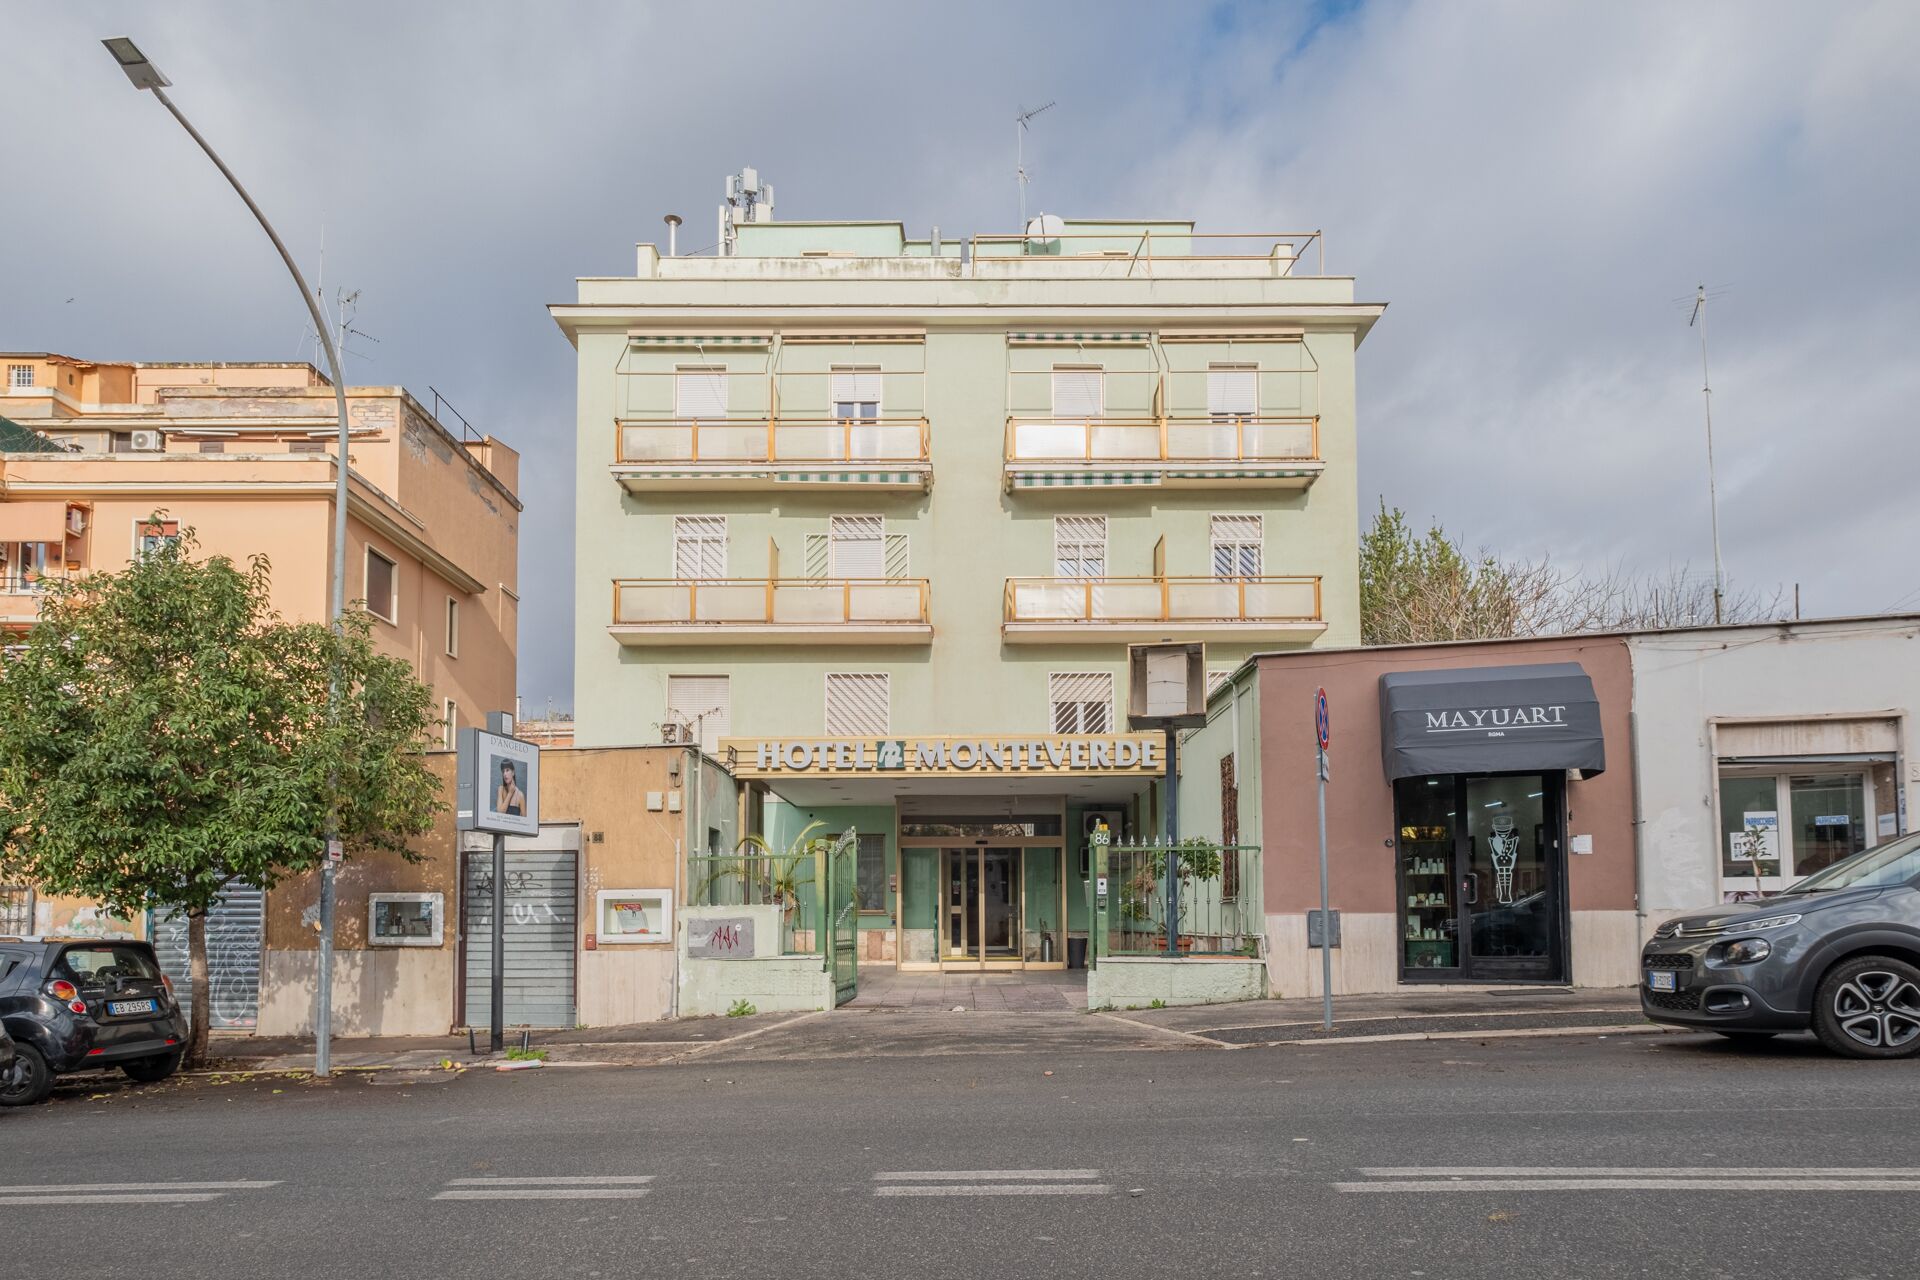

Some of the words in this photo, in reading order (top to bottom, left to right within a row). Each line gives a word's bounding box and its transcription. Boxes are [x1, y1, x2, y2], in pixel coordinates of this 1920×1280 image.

[1425, 705, 1566, 728] MAYUART
[490, 736, 529, 754] D'ANGELO
[757, 741, 873, 771] HOTEL
[915, 740, 1160, 770] MONTEVERDE
[1095, 833, 1109, 845] 86
